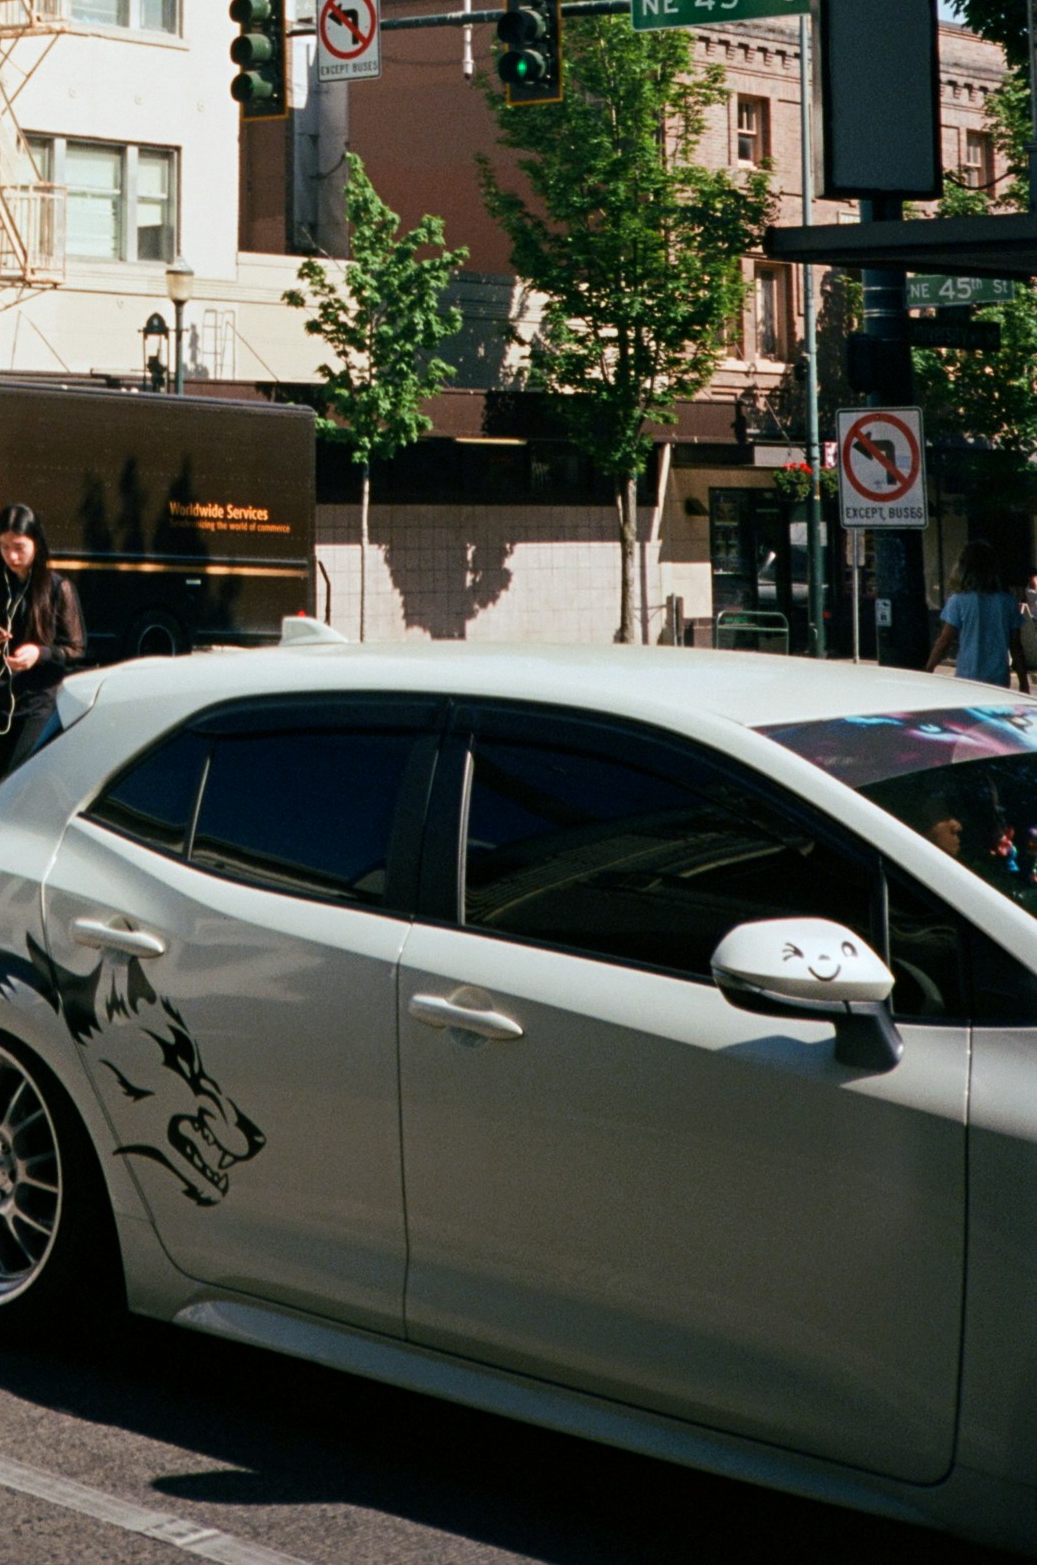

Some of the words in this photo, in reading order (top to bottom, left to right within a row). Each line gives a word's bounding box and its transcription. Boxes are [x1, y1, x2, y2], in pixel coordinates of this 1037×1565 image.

[320, 63, 349, 76] EXCEPT
[352, 60, 379, 73] BUSES
[909, 283, 931, 298] NE
[938, 277, 983, 300] 45th
[992, 279, 1008, 294] St
[169, 501, 225, 519] Worldwide
[226, 503, 269, 521] Services
[845, 507, 885, 520] EXCEPT
[888, 507, 924, 519] BUSES
[216, 520, 228, 531] the
[228, 522, 248, 532] world
[248, 522, 257, 532] of
[257, 523, 291, 534] commerce
